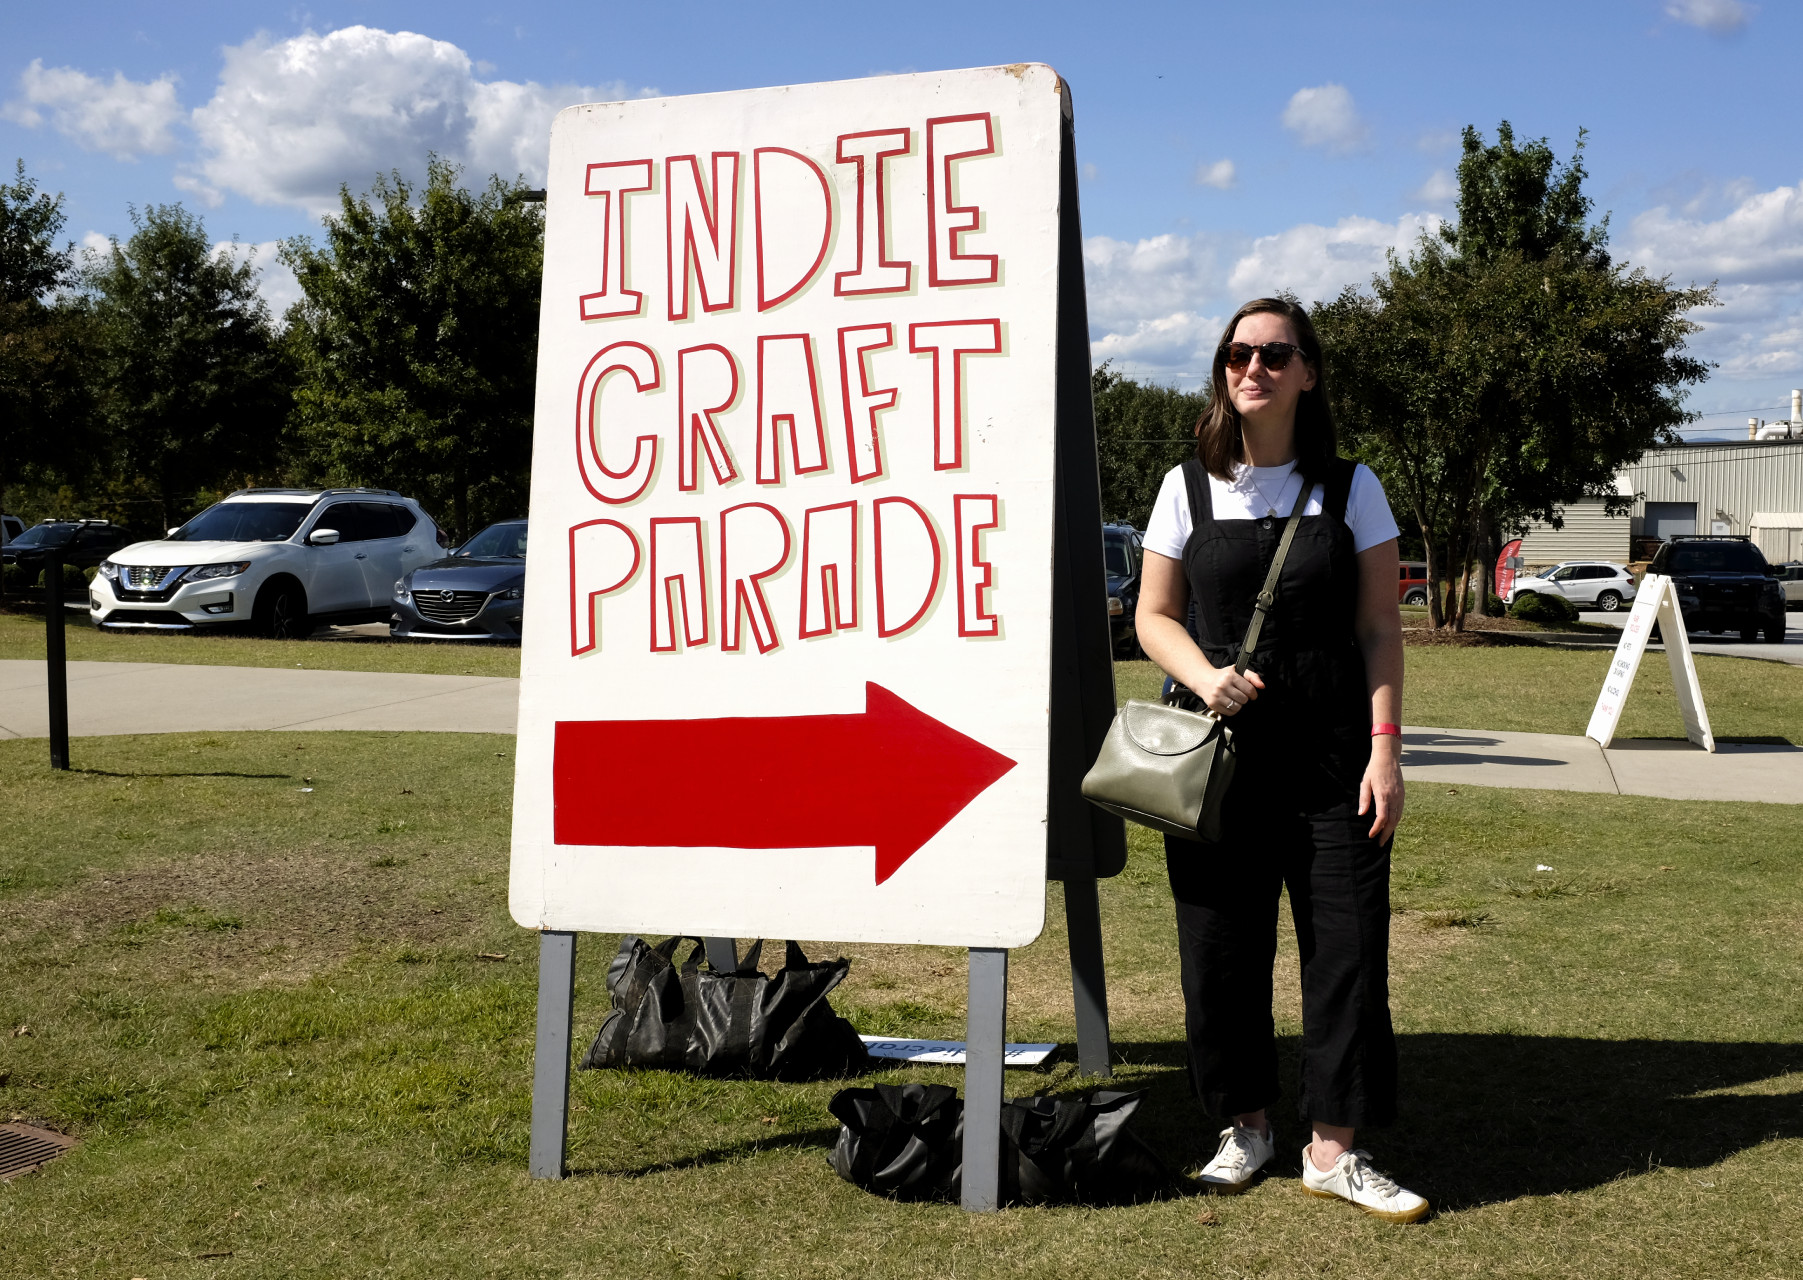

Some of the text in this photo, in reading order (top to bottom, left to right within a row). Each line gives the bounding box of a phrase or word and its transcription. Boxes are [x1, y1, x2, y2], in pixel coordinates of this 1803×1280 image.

[580, 112, 1006, 323] INDIE
[576, 319, 1006, 506] CRAFT
[569, 494, 1003, 658] PARADE
